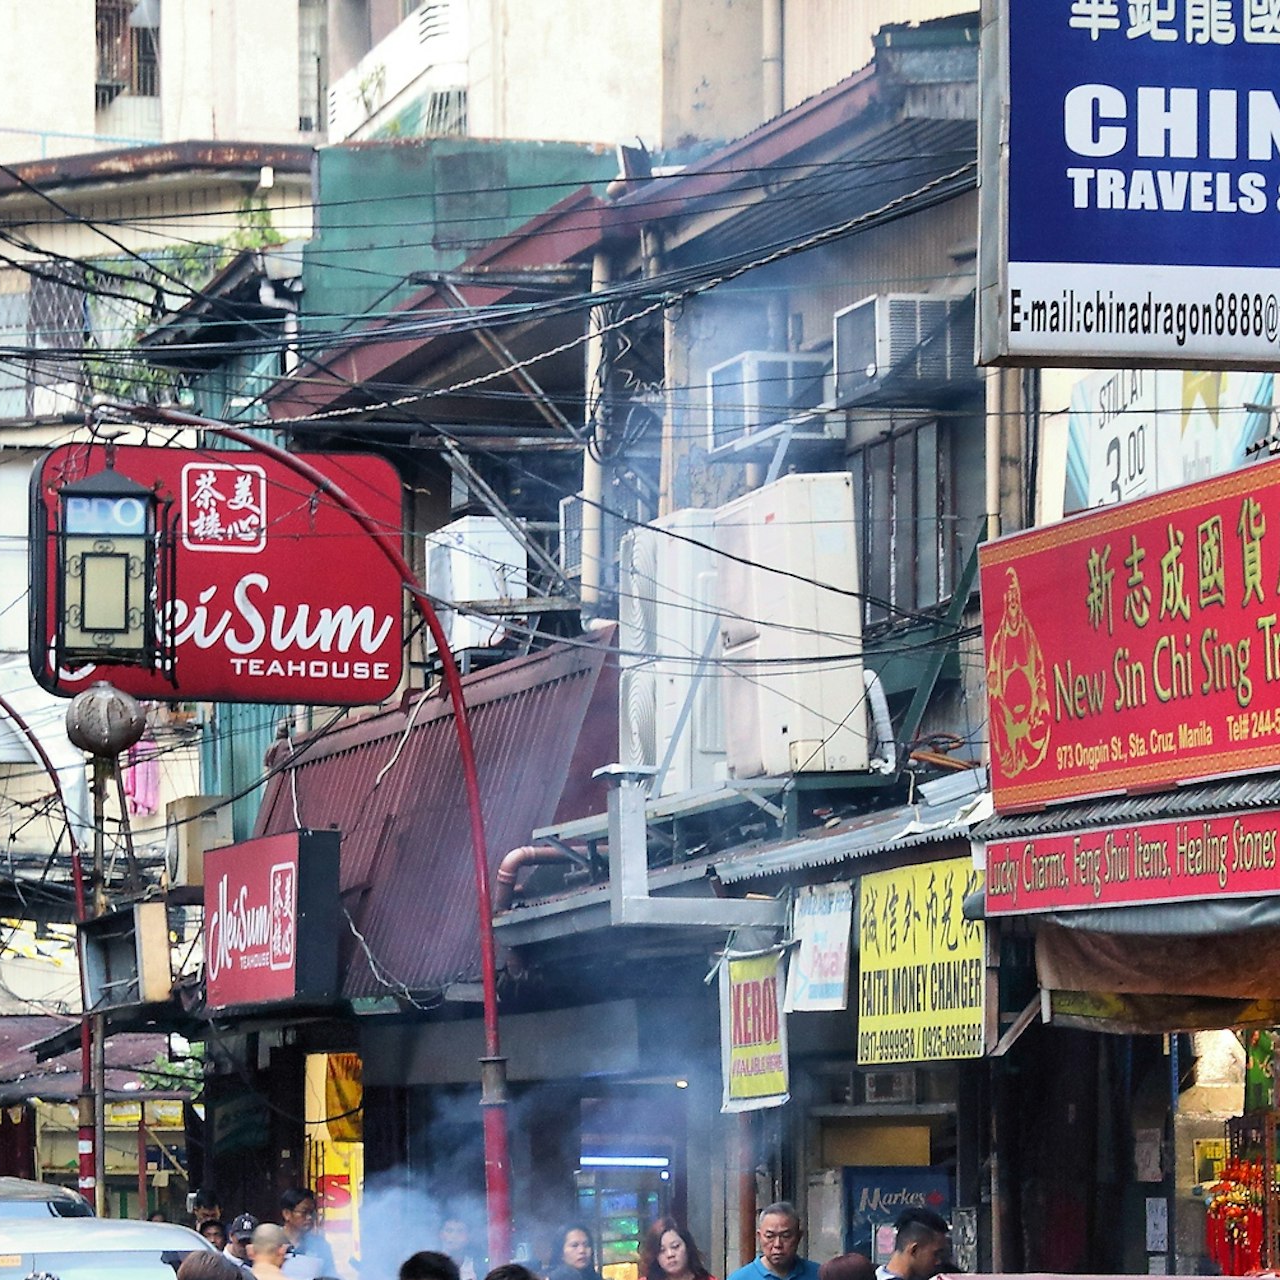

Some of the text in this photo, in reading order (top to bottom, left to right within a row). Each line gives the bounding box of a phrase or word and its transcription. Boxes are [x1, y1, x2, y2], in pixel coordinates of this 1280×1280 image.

[1067, 168, 1267, 212] TRAVELS
[231, 660, 390, 680] TEAHOUSE
[1053, 663, 1106, 722] New
[1114, 647, 1147, 710] Sin
[1152, 634, 1193, 701] Chi
[1200, 623, 1252, 706] Sing
[1057, 746, 1075, 770] 973
[1075, 740, 1110, 771] Ongpin
[1129, 735, 1149, 758] Sta.
[1178, 721, 1213, 747] Manila
[1226, 715, 1250, 742] Tel#
[987, 849, 1019, 904] Lucky
[1073, 835, 1101, 898] Feng
[1105, 833, 1131, 883] Shui
[1175, 822, 1229, 887] Healing
[1231, 819, 1277, 872] Stones
[240, 952, 270, 971] TEAHOUSE
[862, 968, 890, 1018] FAITH
[892, 963, 929, 1014] MONEY
[931, 958, 982, 1010] CHANGER
